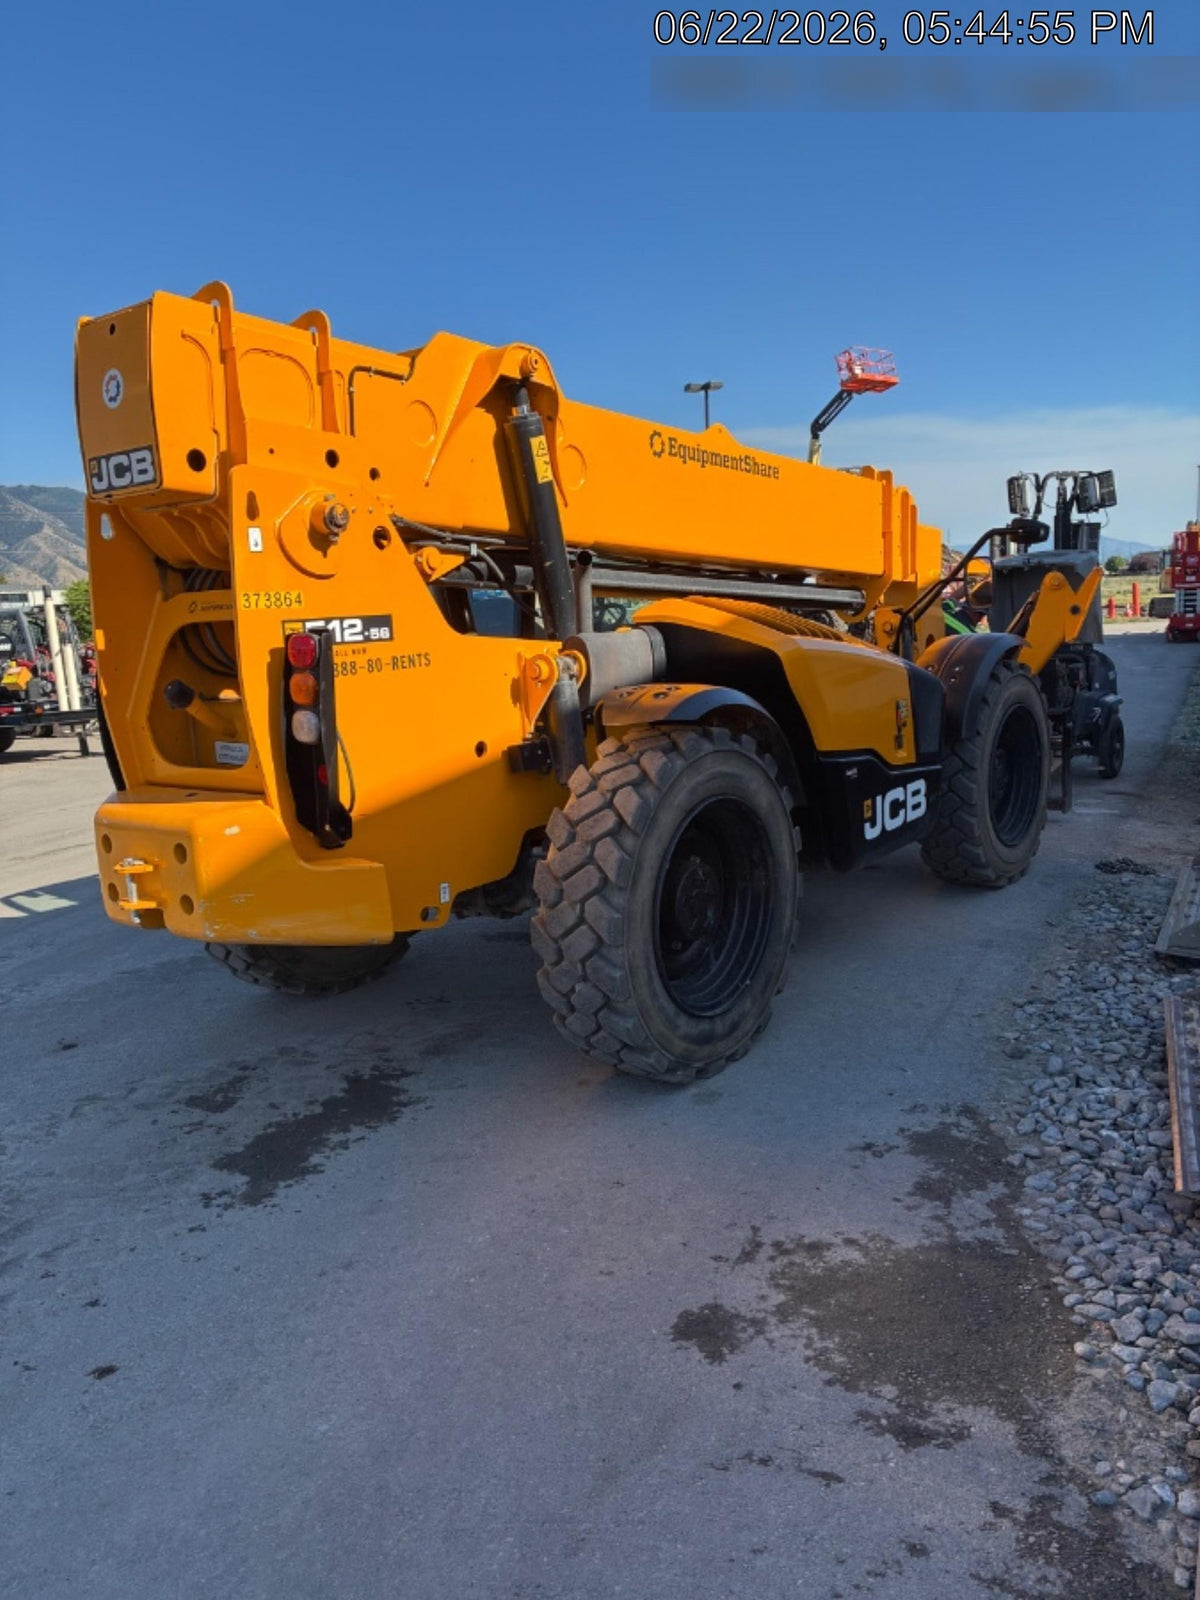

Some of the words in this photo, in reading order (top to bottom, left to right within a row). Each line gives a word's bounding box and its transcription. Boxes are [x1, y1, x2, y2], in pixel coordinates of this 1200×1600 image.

[91, 449, 155, 491] JCB
[668, 437, 780, 480] EquipmentShare
[242, 592, 303, 609] 373864
[863, 778, 927, 840] JCB
